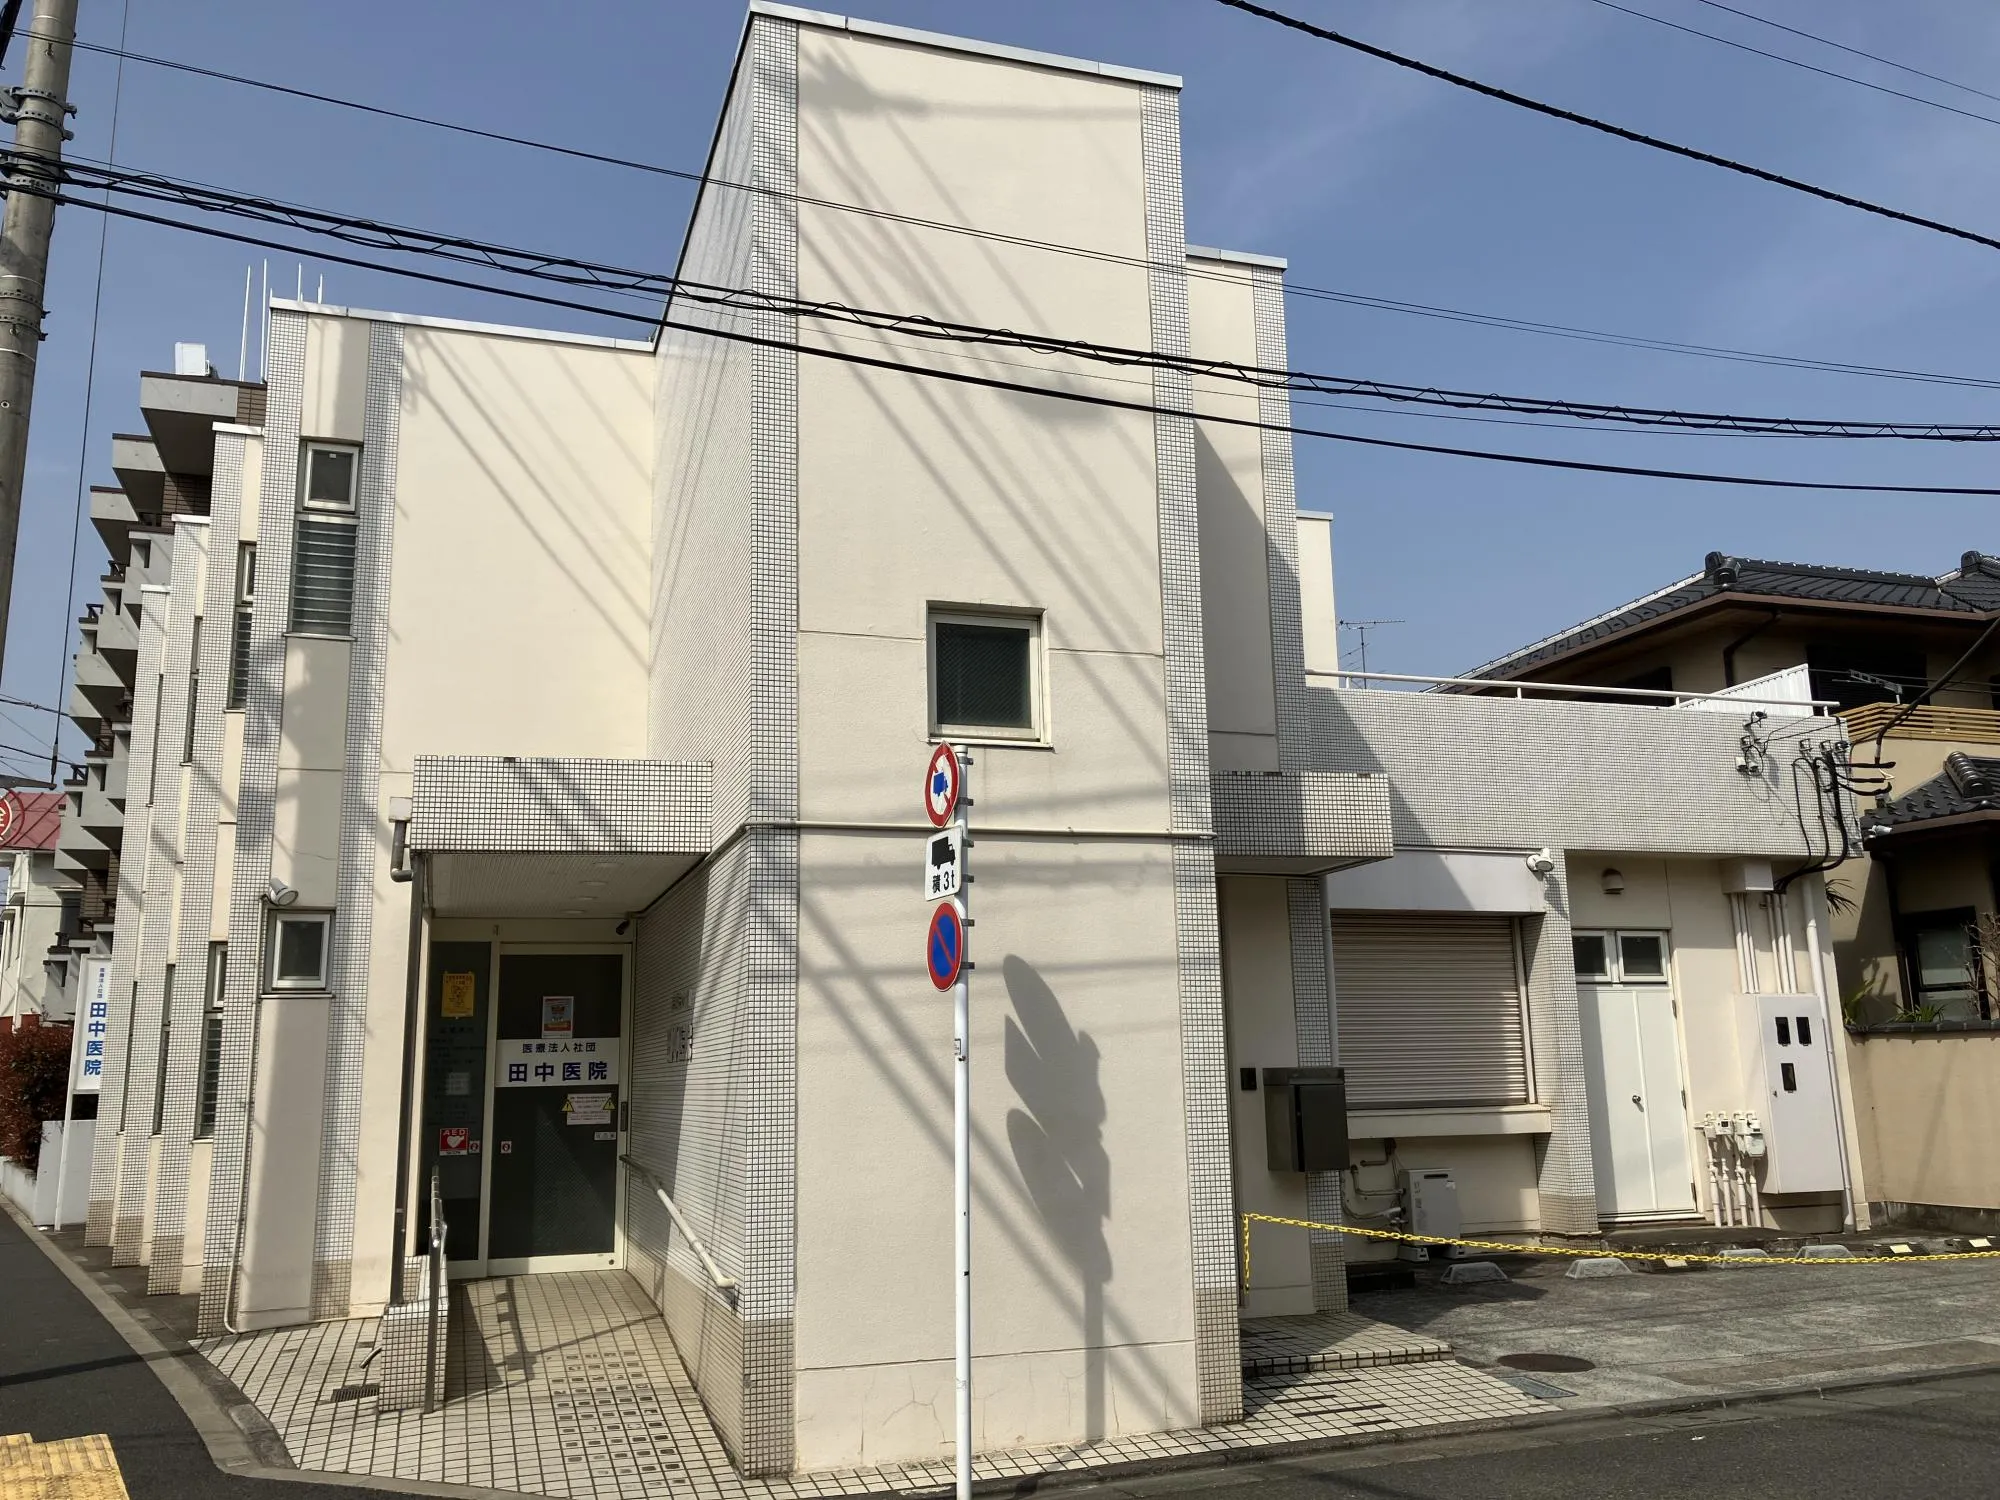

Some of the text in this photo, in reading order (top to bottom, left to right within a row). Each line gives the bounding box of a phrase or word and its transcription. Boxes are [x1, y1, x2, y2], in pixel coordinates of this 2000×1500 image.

[83, 1002, 107, 1076] 田中医院
[522, 1042, 596, 1053] 医療法人社団
[508, 1061, 608, 1082] 田中医院
